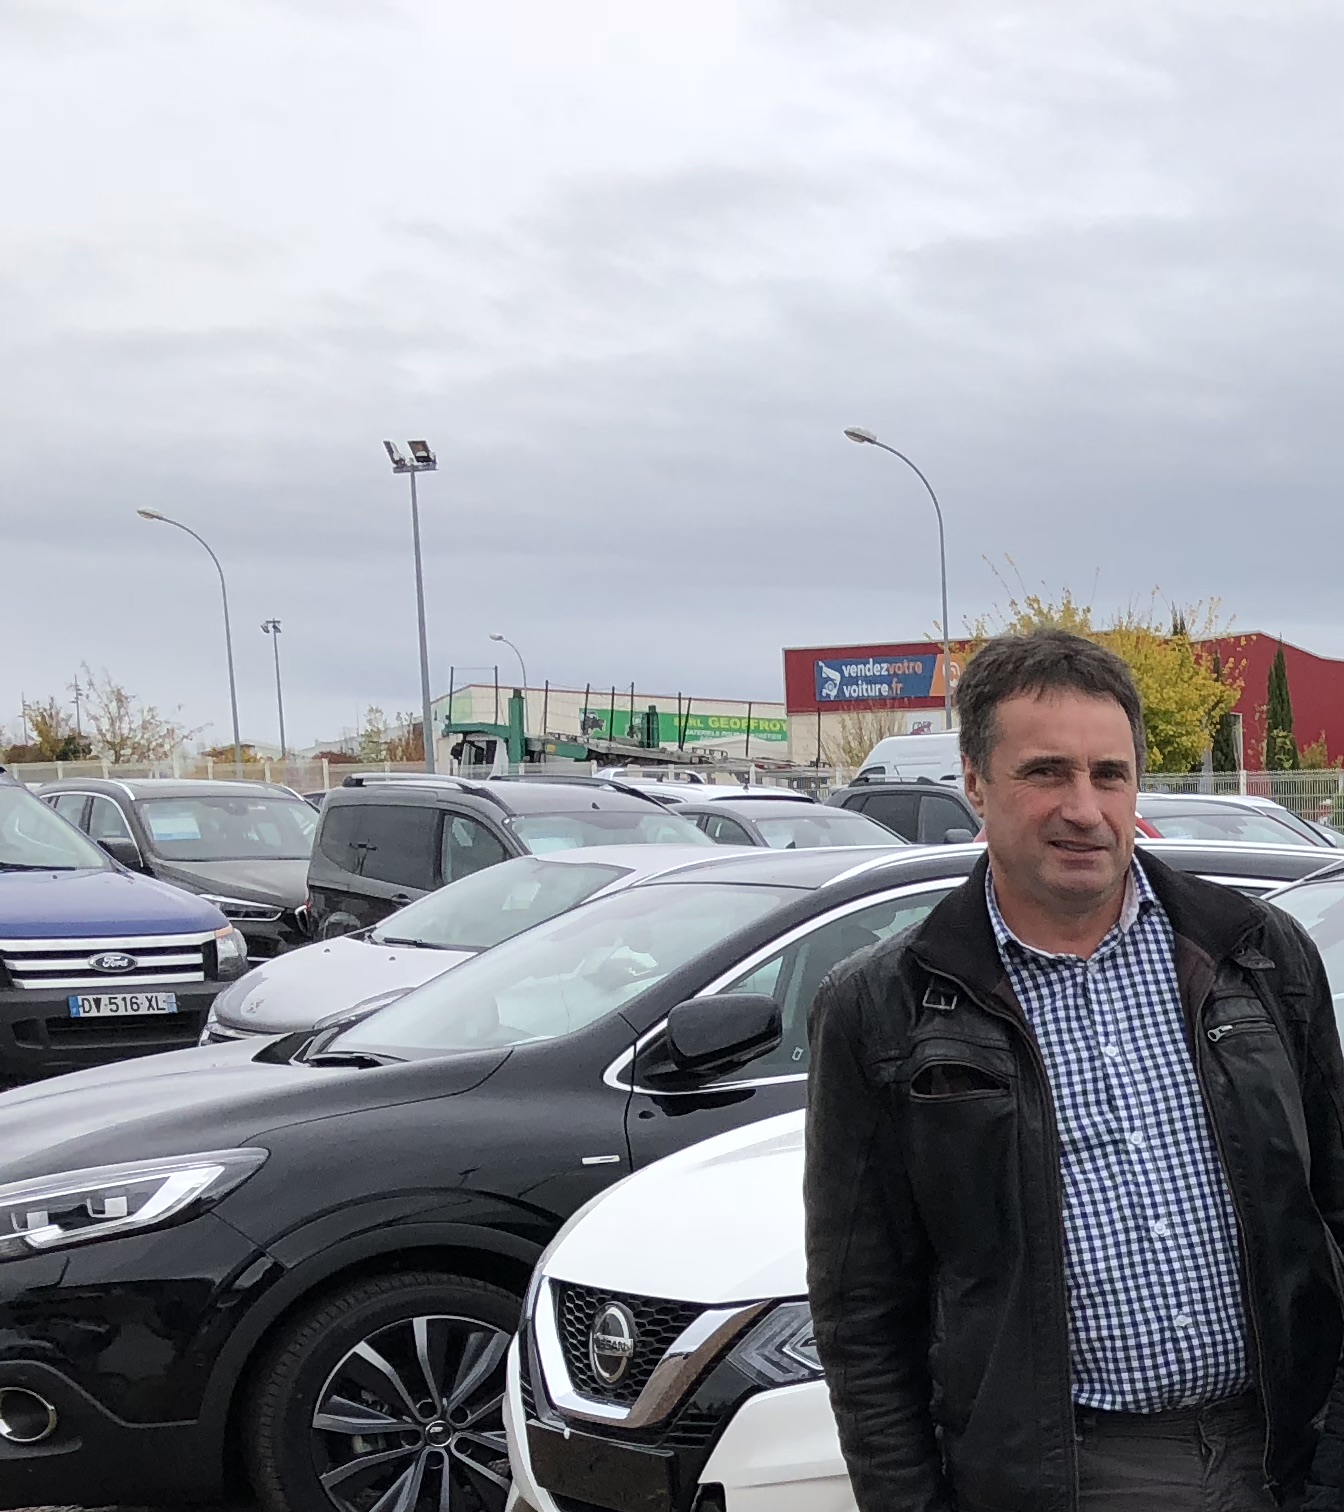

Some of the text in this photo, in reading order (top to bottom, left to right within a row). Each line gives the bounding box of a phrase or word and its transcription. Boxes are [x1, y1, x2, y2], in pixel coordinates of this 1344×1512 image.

[841, 658, 923, 678] vendezvotre
[843, 677, 904, 698] voiture.fr
[708, 716, 788, 731] GEOFFROY
[102, 956, 129, 968] Ford
